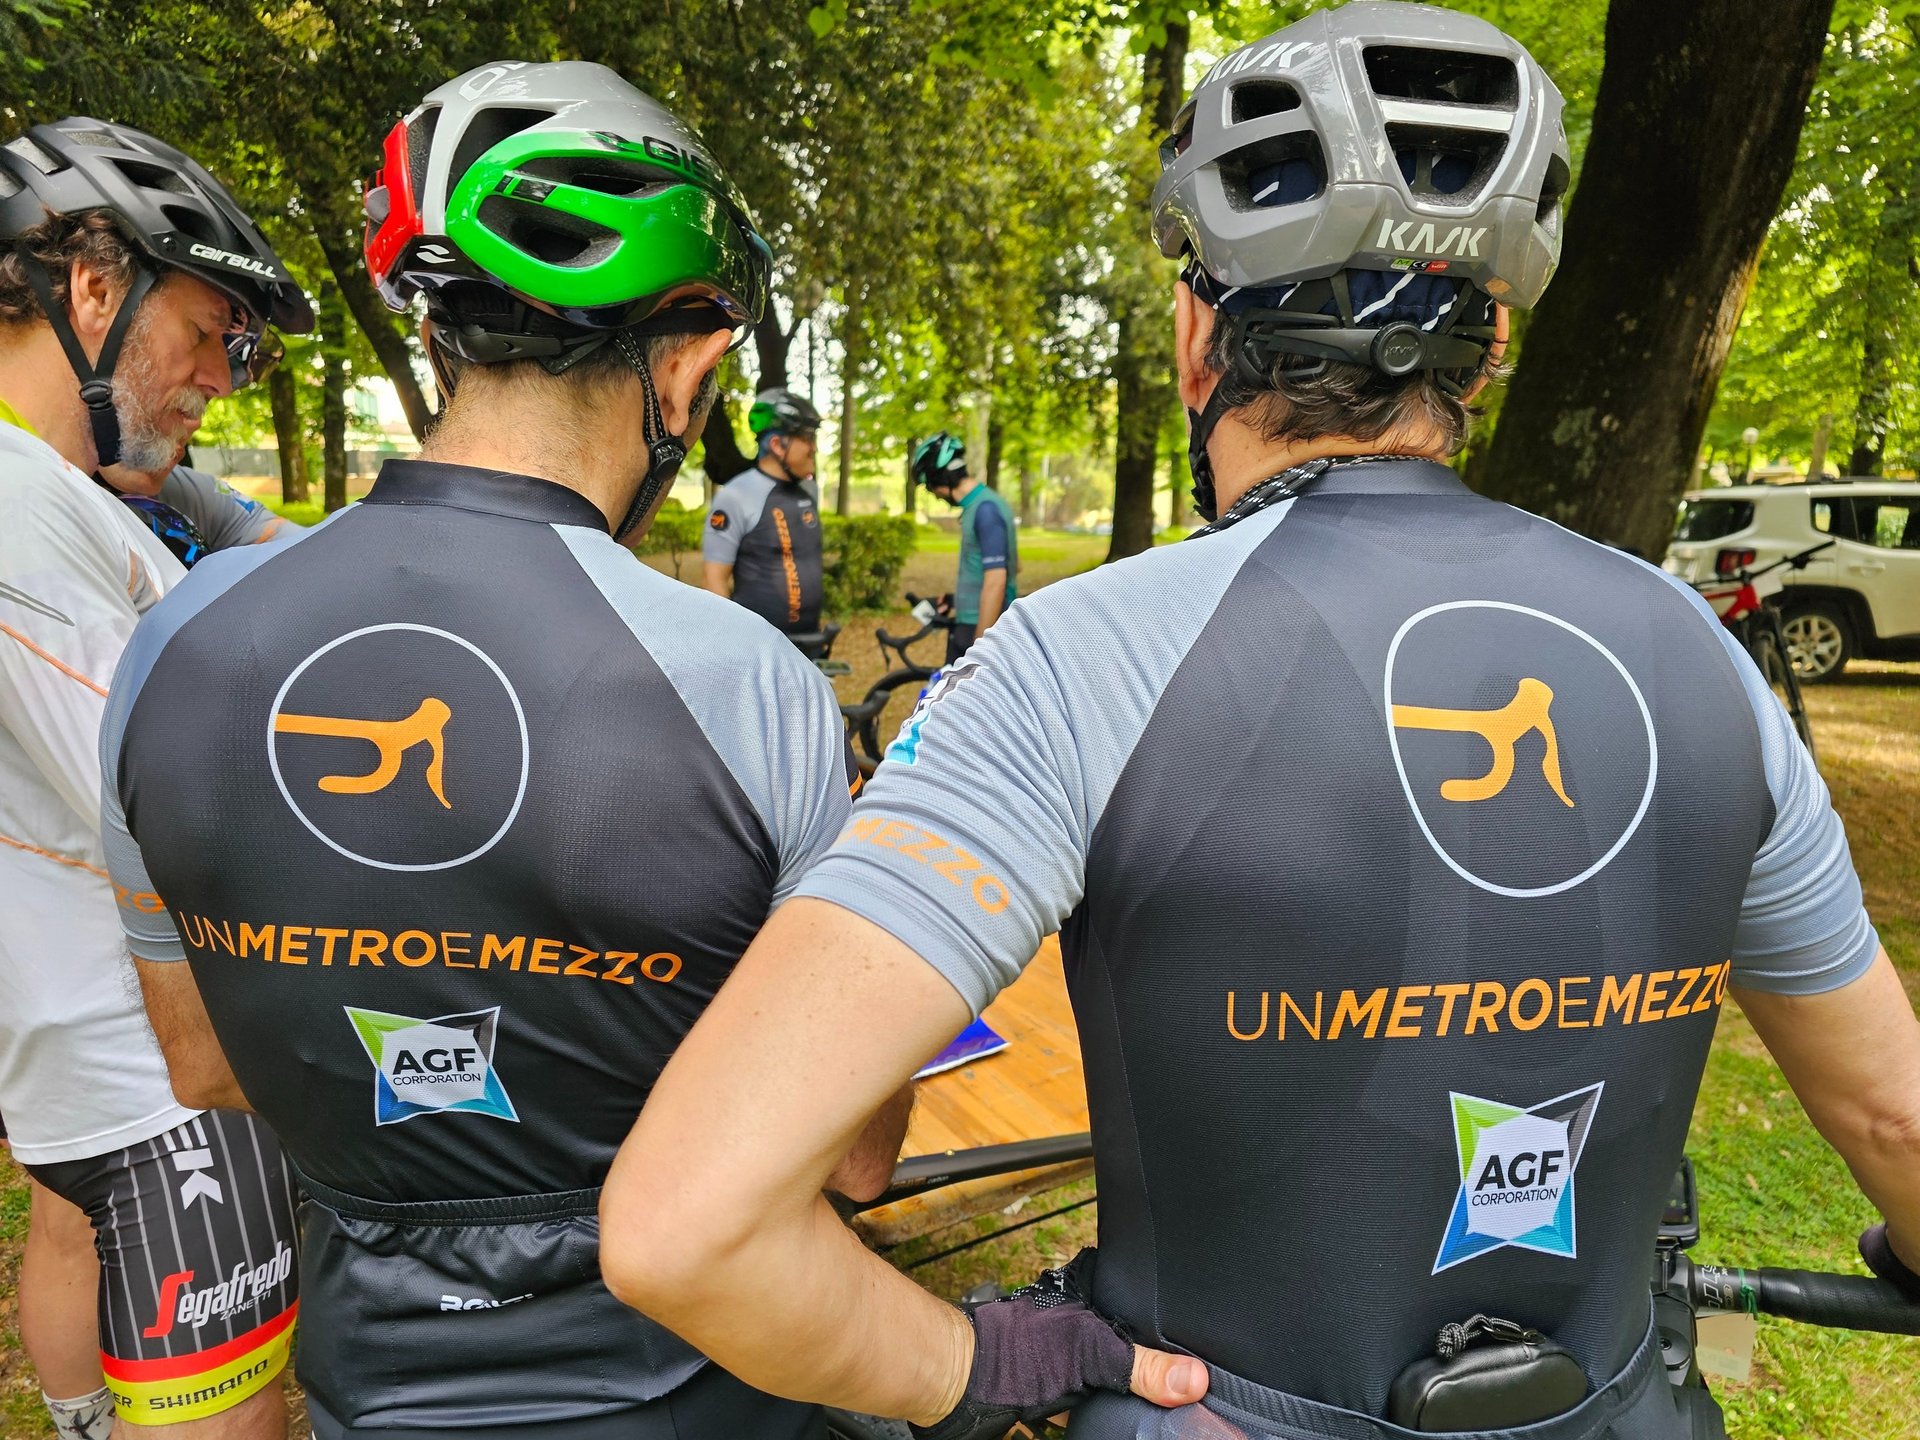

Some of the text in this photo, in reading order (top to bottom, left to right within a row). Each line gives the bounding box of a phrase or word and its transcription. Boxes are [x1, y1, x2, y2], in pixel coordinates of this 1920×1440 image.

[1376, 218, 1488, 257] KASK
[178, 910, 684, 985] UNMETROEMEZZO
[392, 1048, 477, 1075] AGF
[392, 1073, 481, 1086] CORPORATION
[1474, 1149, 1565, 1192] AGF
[1471, 1188, 1559, 1207] CORPORATION
[143, 1240, 292, 1339] Segafredo
[219, 1289, 271, 1321] ZANETTI
